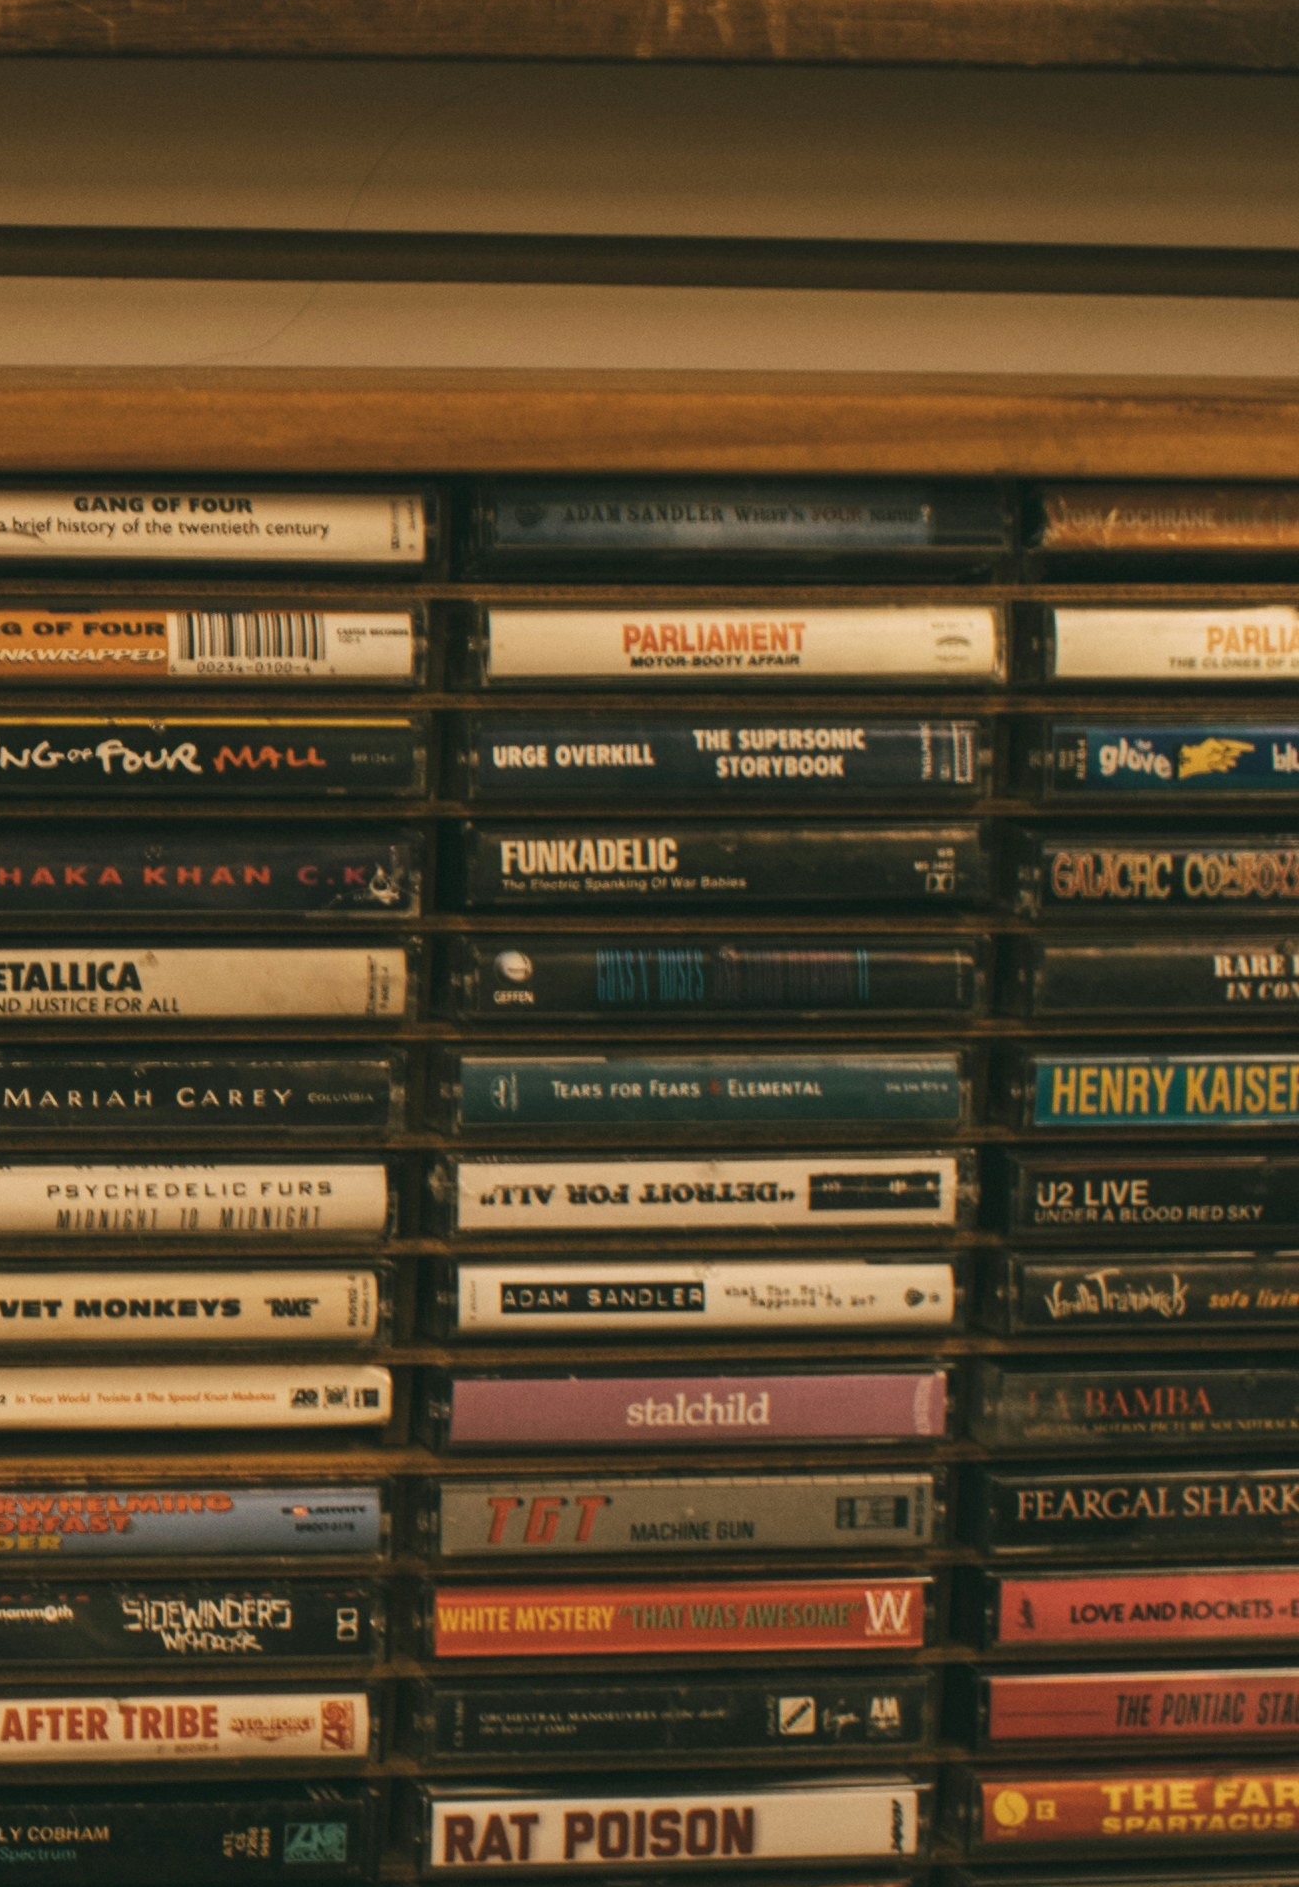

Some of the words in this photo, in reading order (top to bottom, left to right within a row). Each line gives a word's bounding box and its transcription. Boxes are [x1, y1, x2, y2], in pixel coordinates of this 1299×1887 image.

[501, 838, 677, 873] FUNKADELIC
[626, 1393, 770, 1426] stalchild
[2, 1707, 108, 1740] AFTER
[120, 1704, 220, 1738] TRIBE
[444, 1815, 537, 1861] RAT
[564, 1808, 753, 1860] POISON
